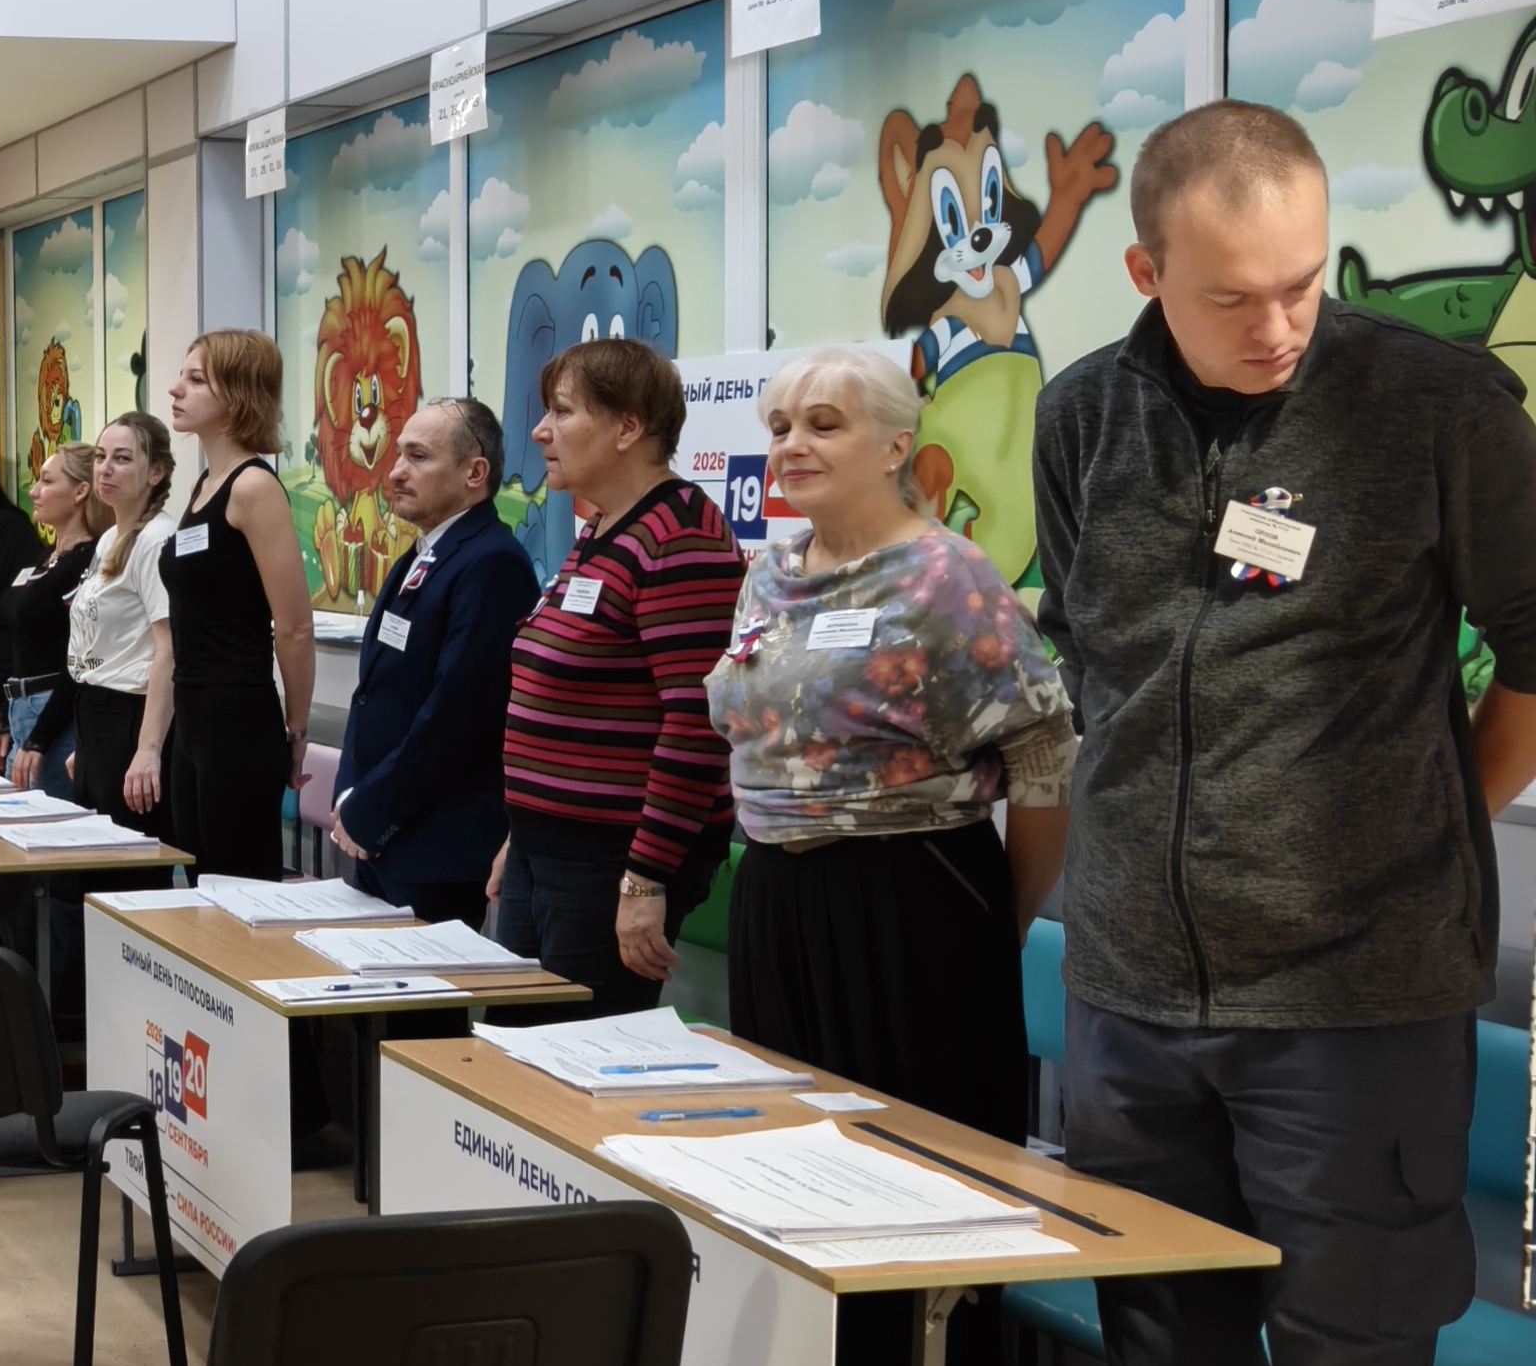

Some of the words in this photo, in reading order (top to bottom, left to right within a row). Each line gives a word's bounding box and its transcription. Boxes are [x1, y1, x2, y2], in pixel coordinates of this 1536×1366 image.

[1437, 0, 1456, 10] дом
[683, 377, 711, 403] НЫЙ
[714, 379, 754, 404] ДЕНЬ
[693, 452, 726, 471] 2026
[730, 475, 761, 522] 19
[122, 942, 152, 975] ЕДИНЫЙ
[153, 961, 173, 988] ДЕНЬ
[174, 973, 234, 1026] ГОЛОСОВАНИЯ
[149, 1069, 163, 1112] 18
[166, 1057, 182, 1103] 19
[185, 1048, 205, 1098] 20
[168, 1122, 208, 1168] СЕНТЯБРЯ
[454, 1120, 515, 1178] ЕДИНЫЙ
[519, 1157, 560, 1203] ДЕНЬ
[125, 1146, 144, 1177] ТВОЙ
[176, 1191, 199, 1225] СИЛА
